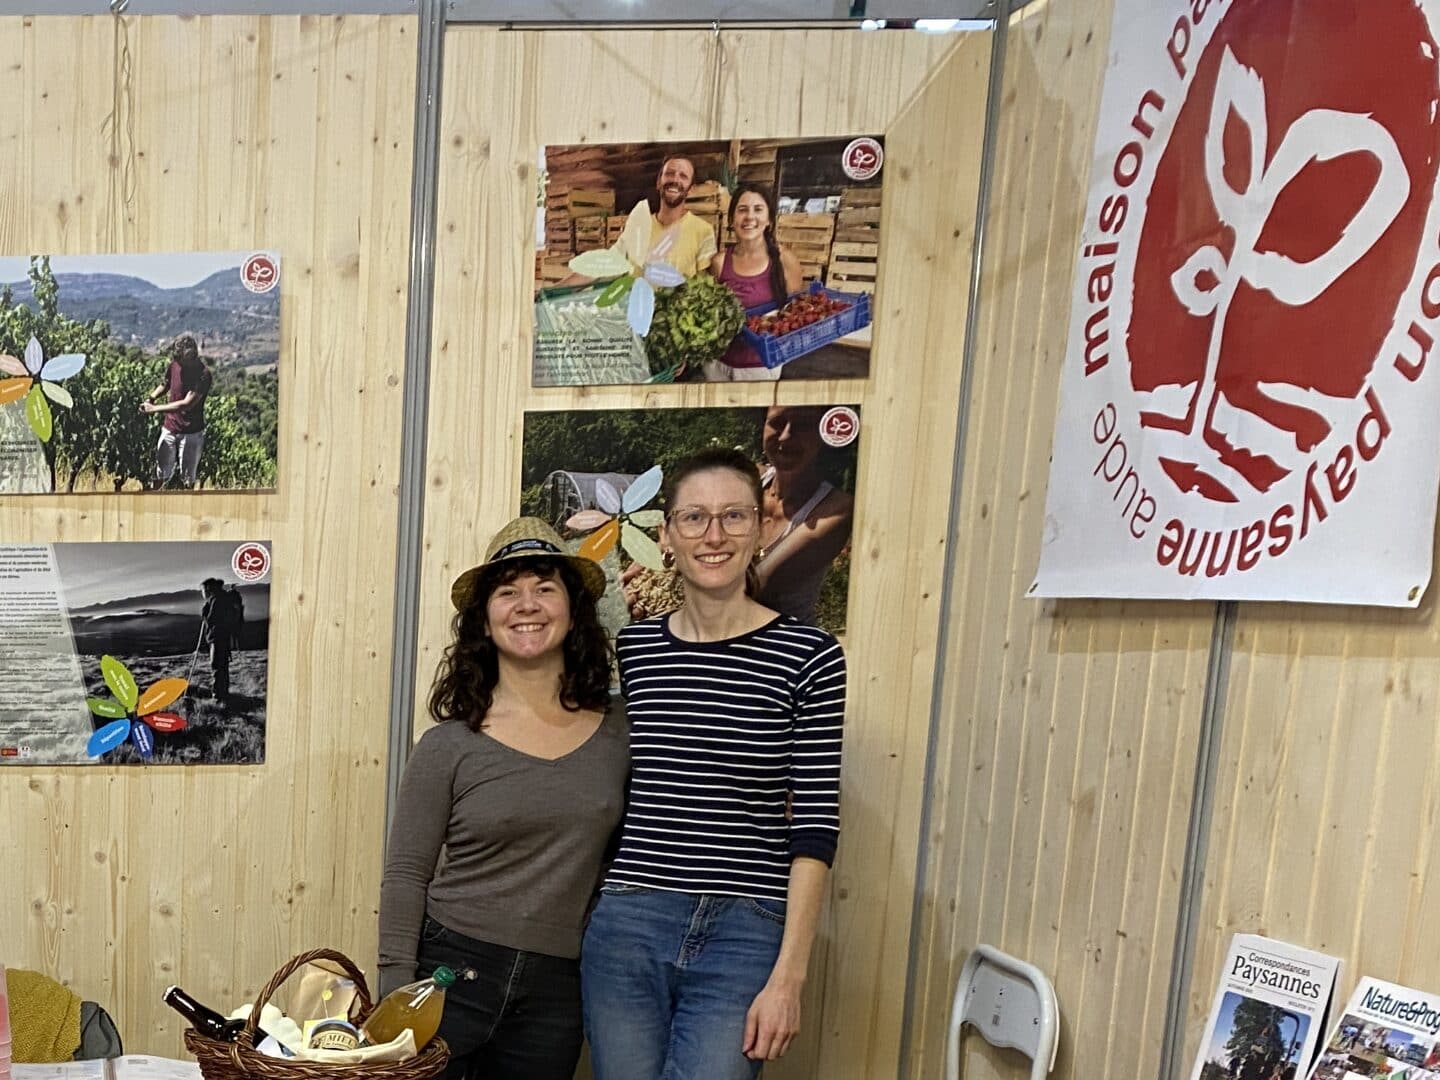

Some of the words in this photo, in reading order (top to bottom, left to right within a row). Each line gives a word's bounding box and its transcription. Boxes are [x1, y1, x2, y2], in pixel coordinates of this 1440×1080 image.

[1084, 87, 1165, 377] maison
[1091, 402, 1158, 539] aude
[1158, 386, 1392, 577] paysanne
[1231, 955, 1321, 999] Paysannes
[1248, 952, 1311, 977] Correspondances
